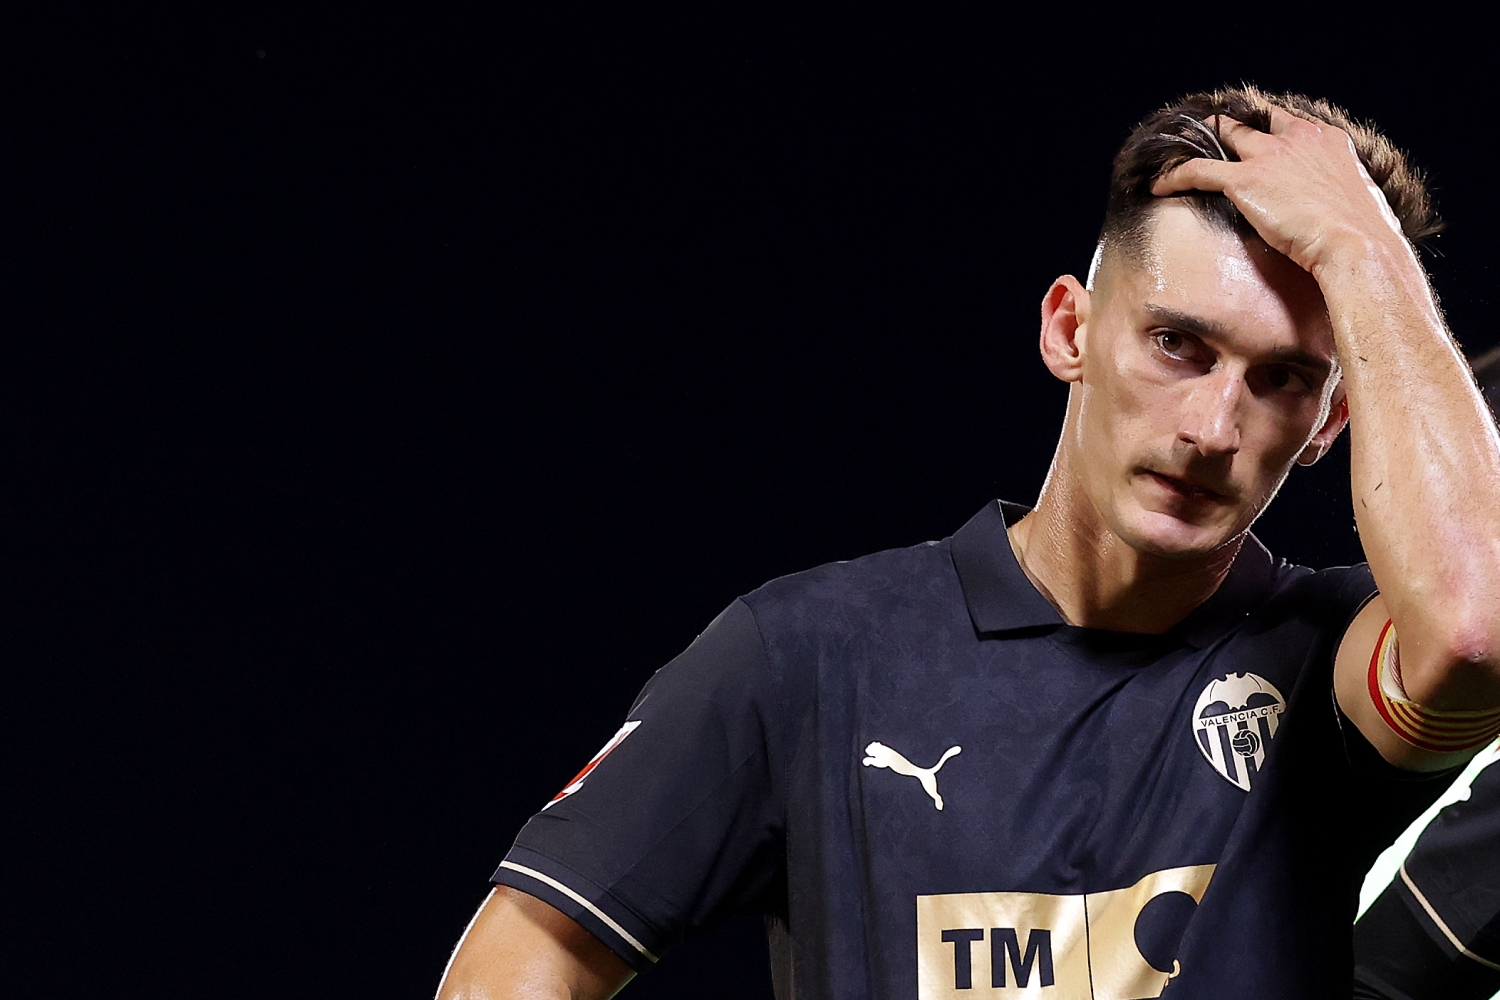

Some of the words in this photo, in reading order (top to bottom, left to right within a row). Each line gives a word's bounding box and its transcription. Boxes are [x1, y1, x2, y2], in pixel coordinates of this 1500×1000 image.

[1200, 710, 1258, 727] VALENCIA
[1260, 705, 1282, 717] C.F.
[941, 927, 1055, 990] TM
